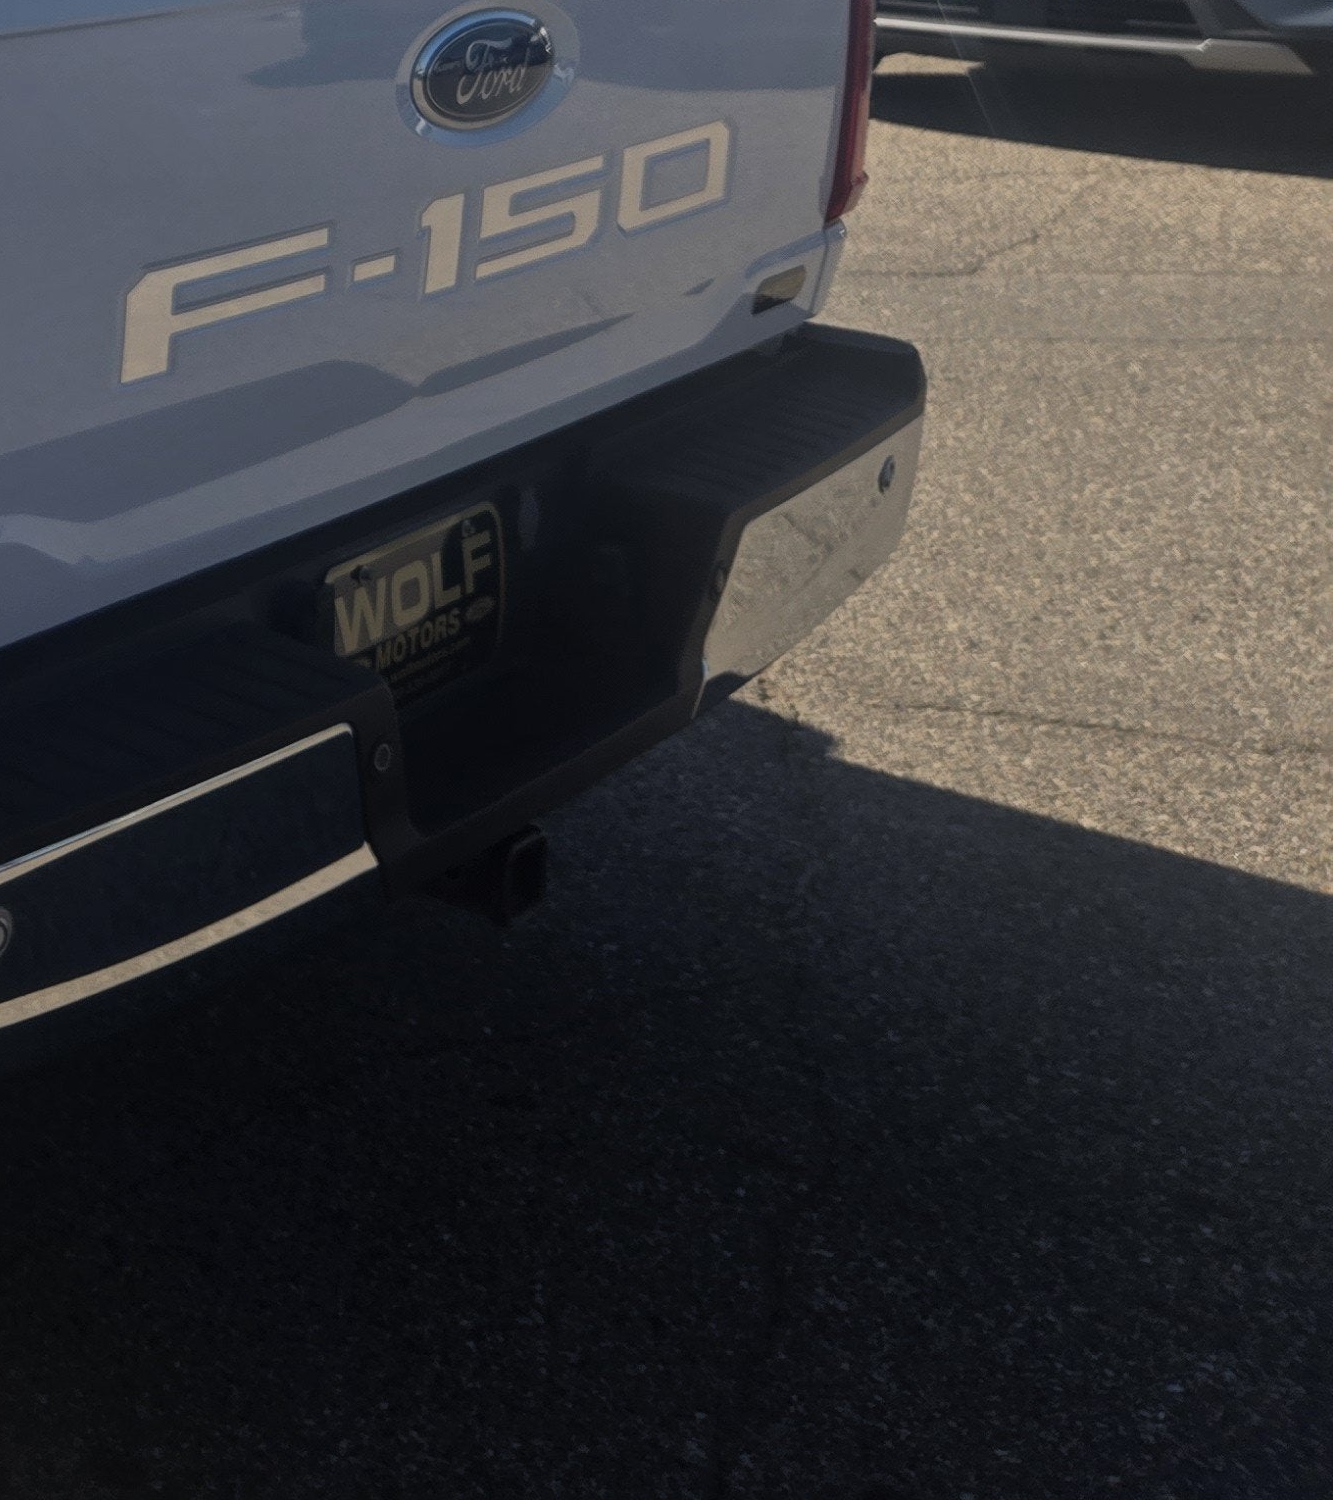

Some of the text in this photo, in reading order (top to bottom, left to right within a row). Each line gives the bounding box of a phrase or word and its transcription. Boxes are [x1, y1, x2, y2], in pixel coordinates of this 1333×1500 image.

[456, 38, 531, 105] Ford
[120, 118, 732, 385] F-150
[334, 530, 492, 656] WOLF
[376, 607, 462, 670] MOTORS
